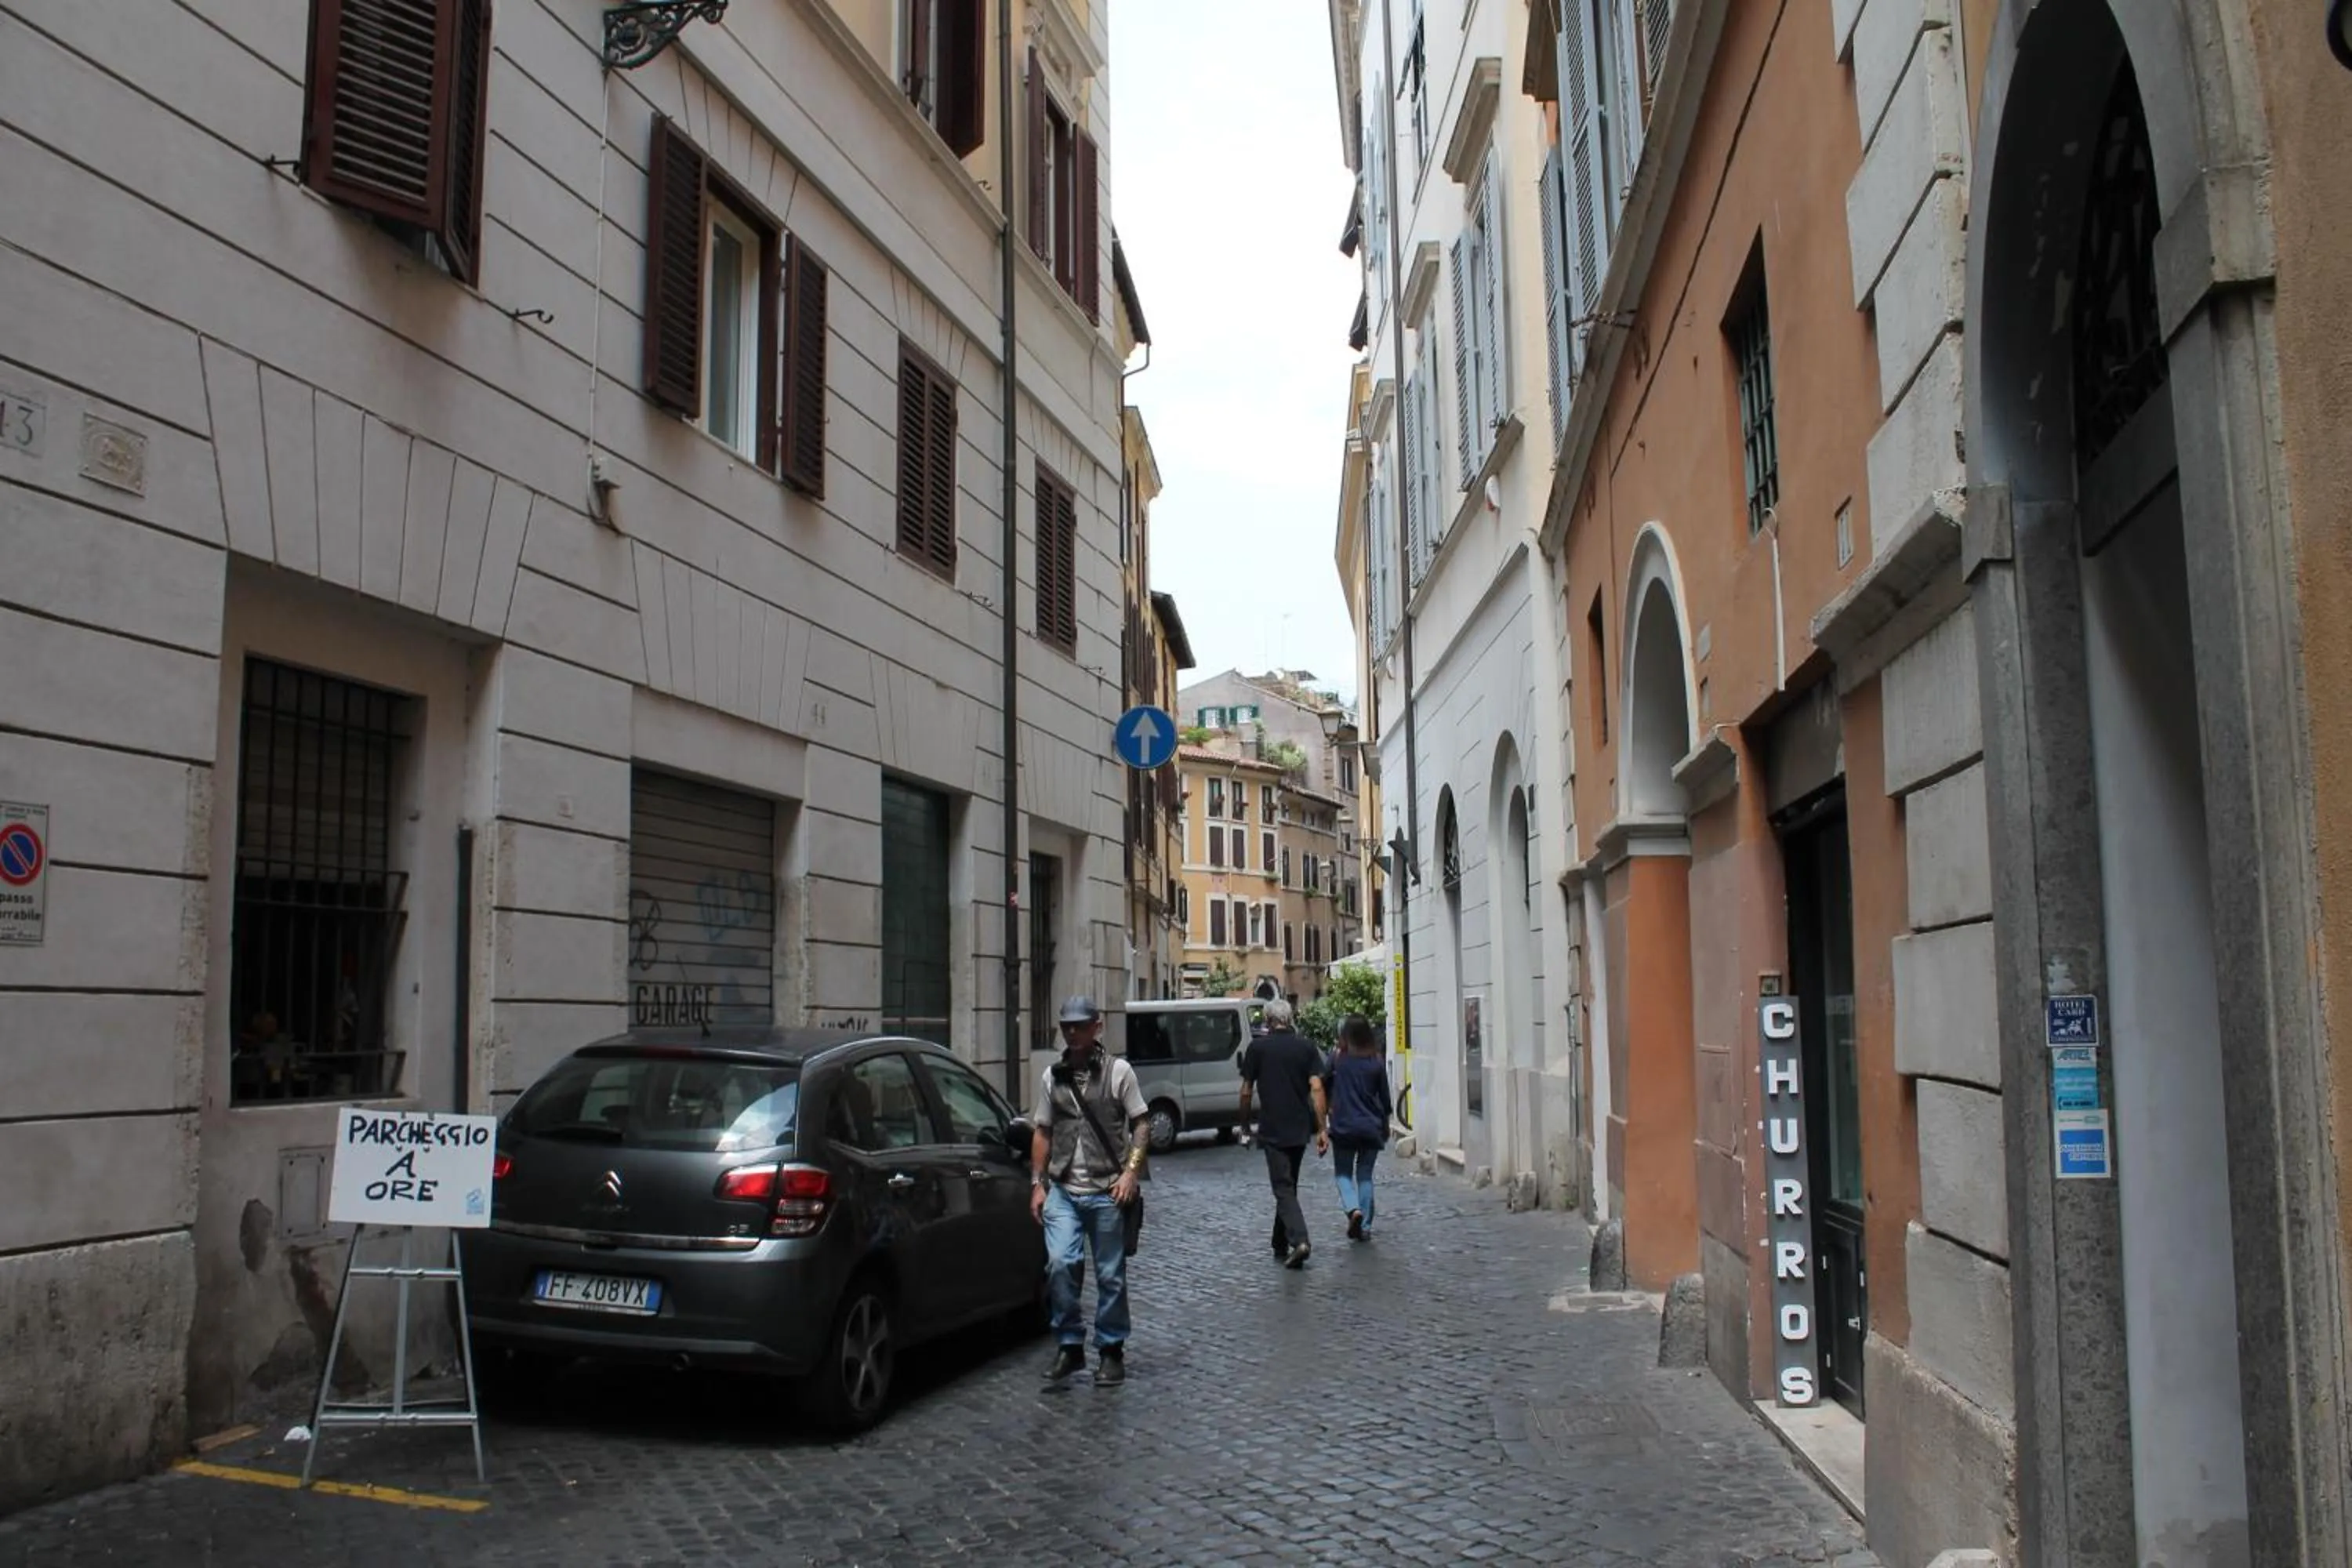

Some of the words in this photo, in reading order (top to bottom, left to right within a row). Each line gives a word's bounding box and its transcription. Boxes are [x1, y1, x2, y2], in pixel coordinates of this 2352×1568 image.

[349, 1116, 488, 1147] PARCHEGGIO
[385, 1150, 416, 1178] A
[365, 1179, 438, 1201] ORE
[1763, 1003, 1813, 1404] CHURROS
